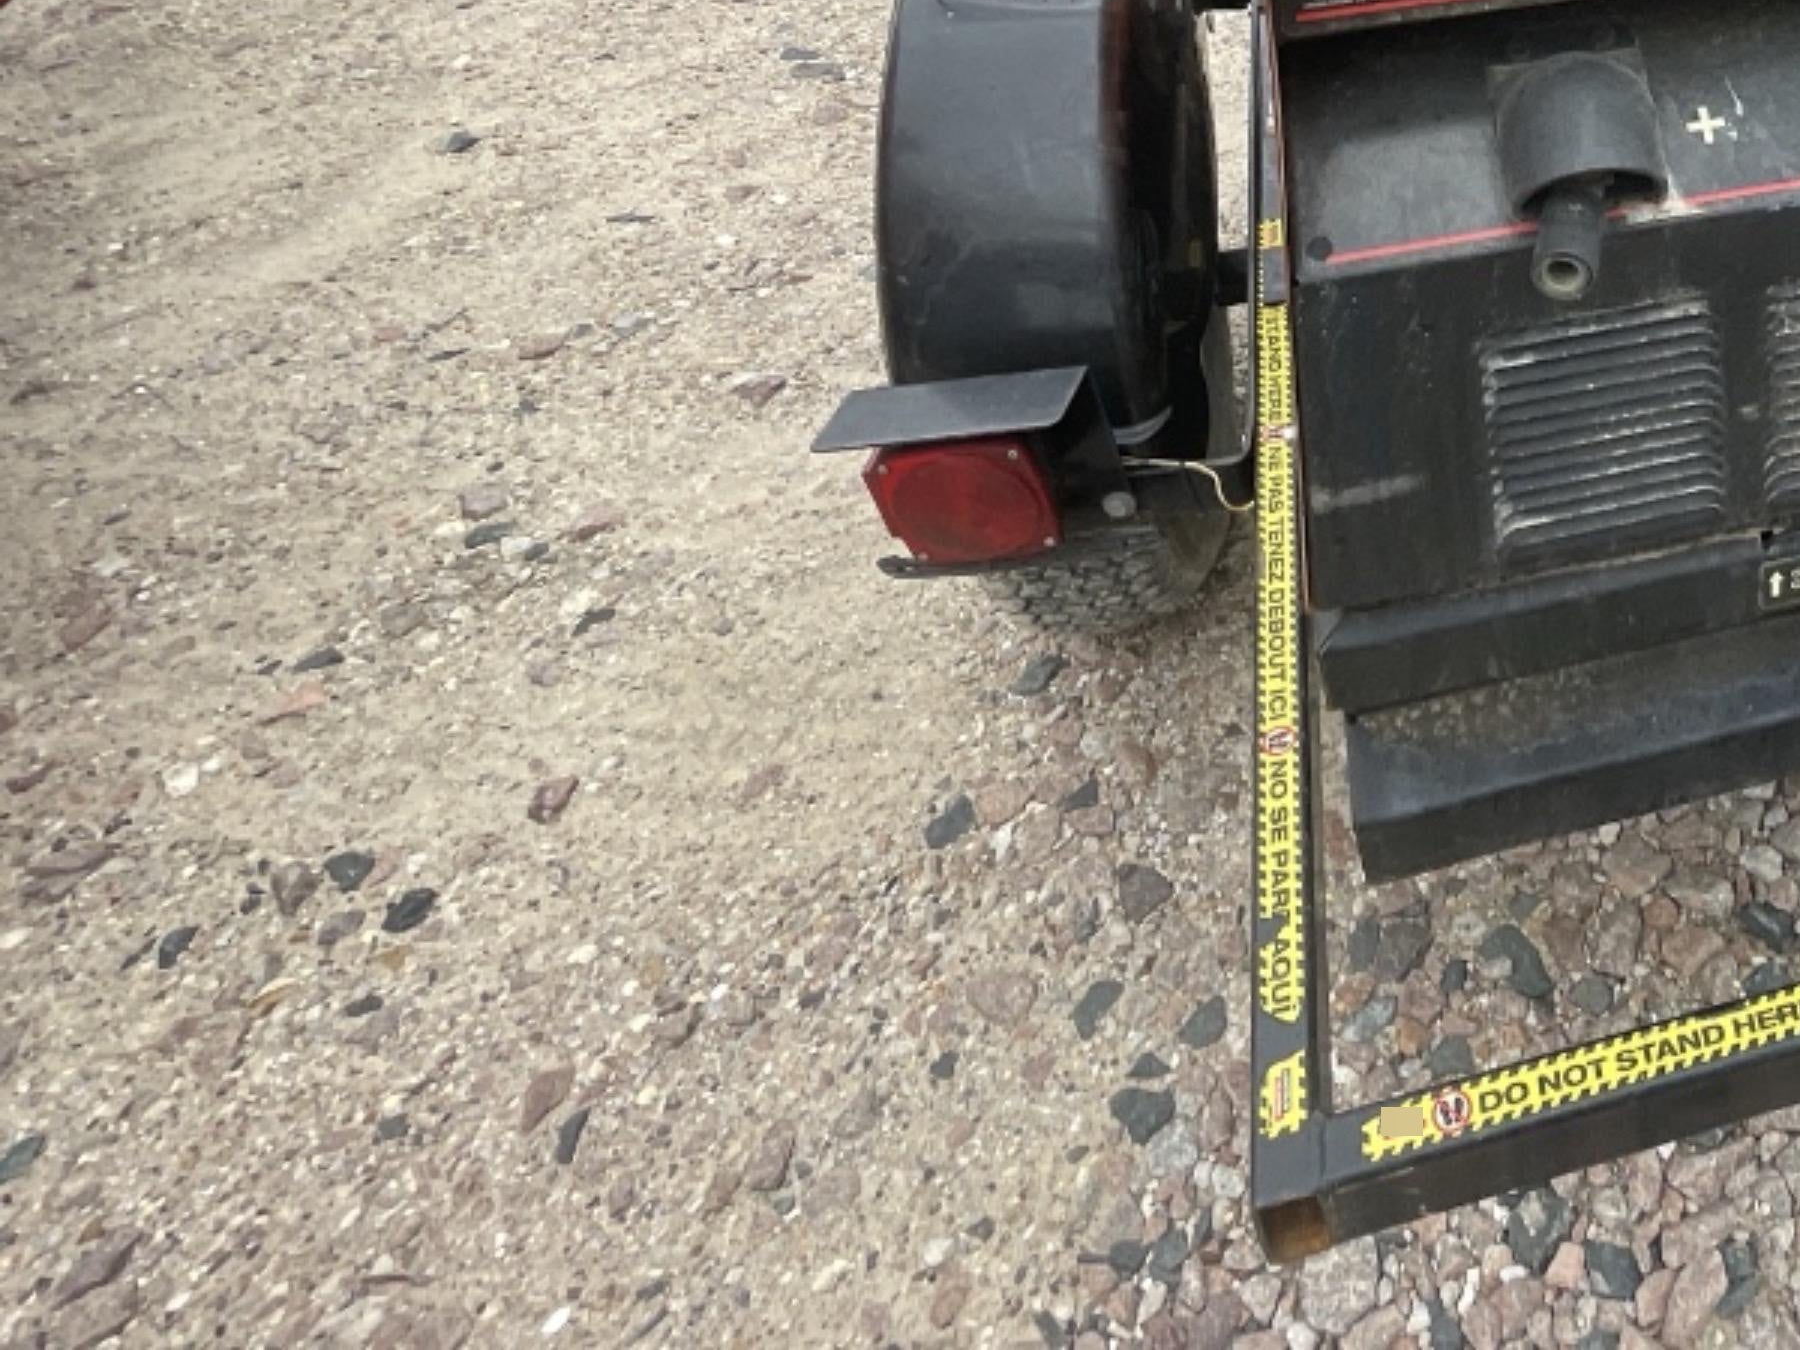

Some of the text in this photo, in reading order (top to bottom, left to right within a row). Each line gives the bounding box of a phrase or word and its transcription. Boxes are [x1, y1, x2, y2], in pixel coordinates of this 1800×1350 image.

[1267, 518, 1286, 586] TENEZ
[1268, 587, 1287, 683] DEBOUT
[1268, 687, 1288, 722] ICI
[1269, 760, 1288, 799] NO
[1270, 805, 1289, 841] SE
[1478, 1081, 1529, 1114] DO
[1538, 1055, 1607, 1097] NOT
[1615, 1022, 1726, 1073] STAND
